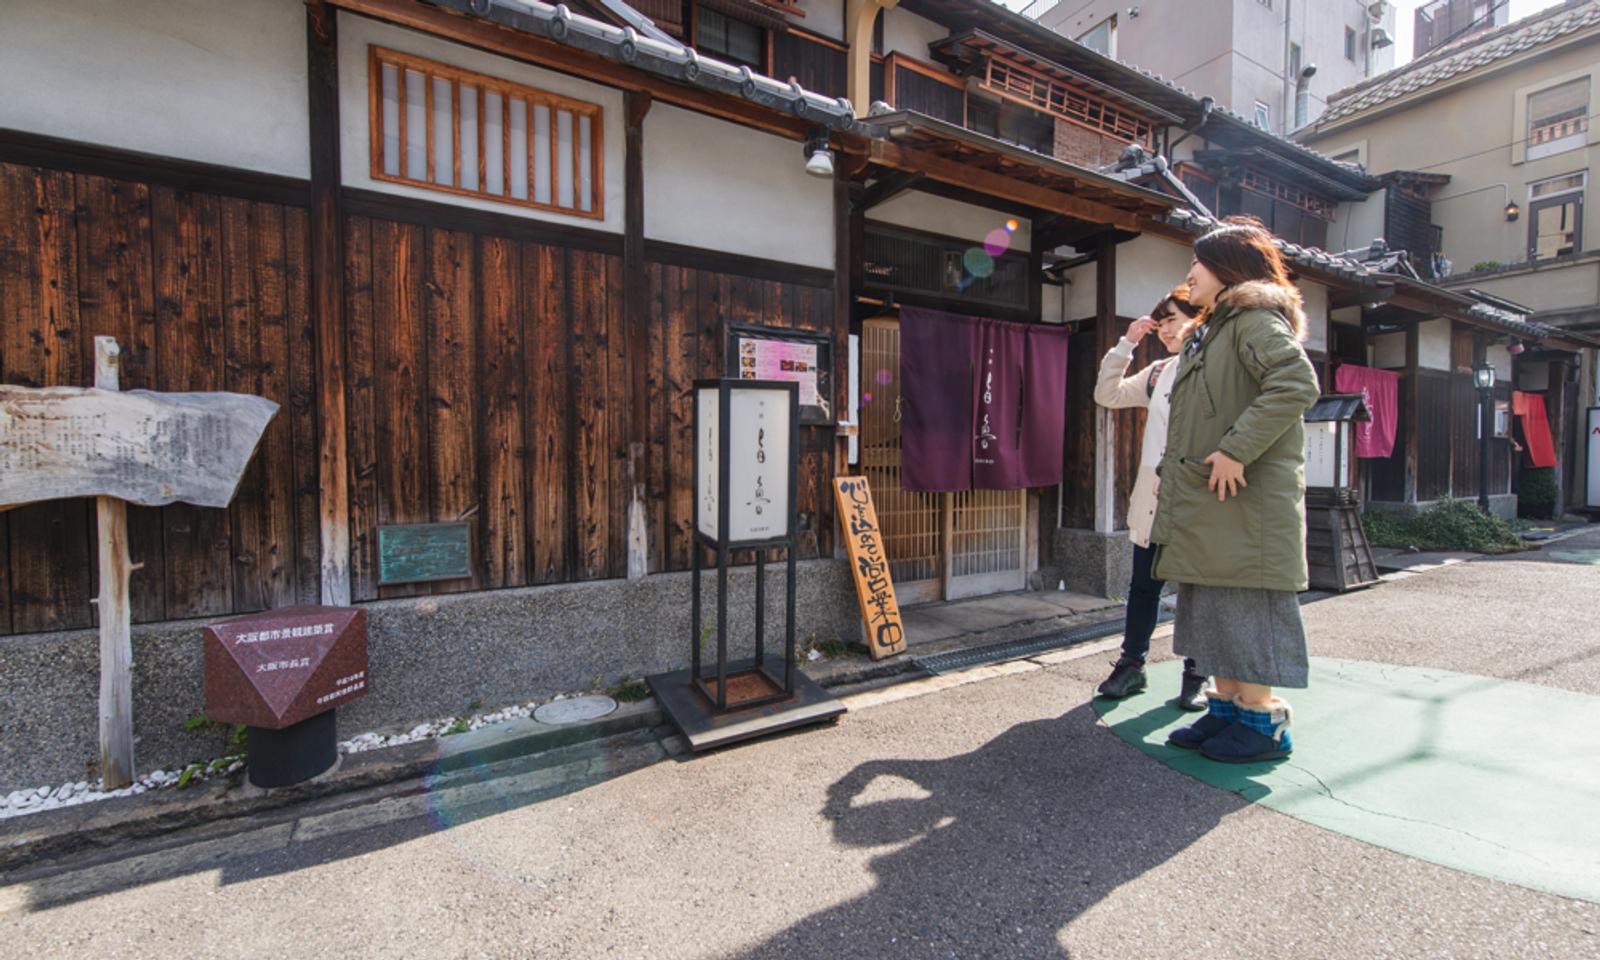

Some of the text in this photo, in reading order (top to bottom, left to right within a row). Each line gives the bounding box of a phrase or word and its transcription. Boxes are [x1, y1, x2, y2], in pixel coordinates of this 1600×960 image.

[235, 623, 334, 645] 大阪都市景観建築賞
[256, 657, 310, 673] 大阪市長賞
